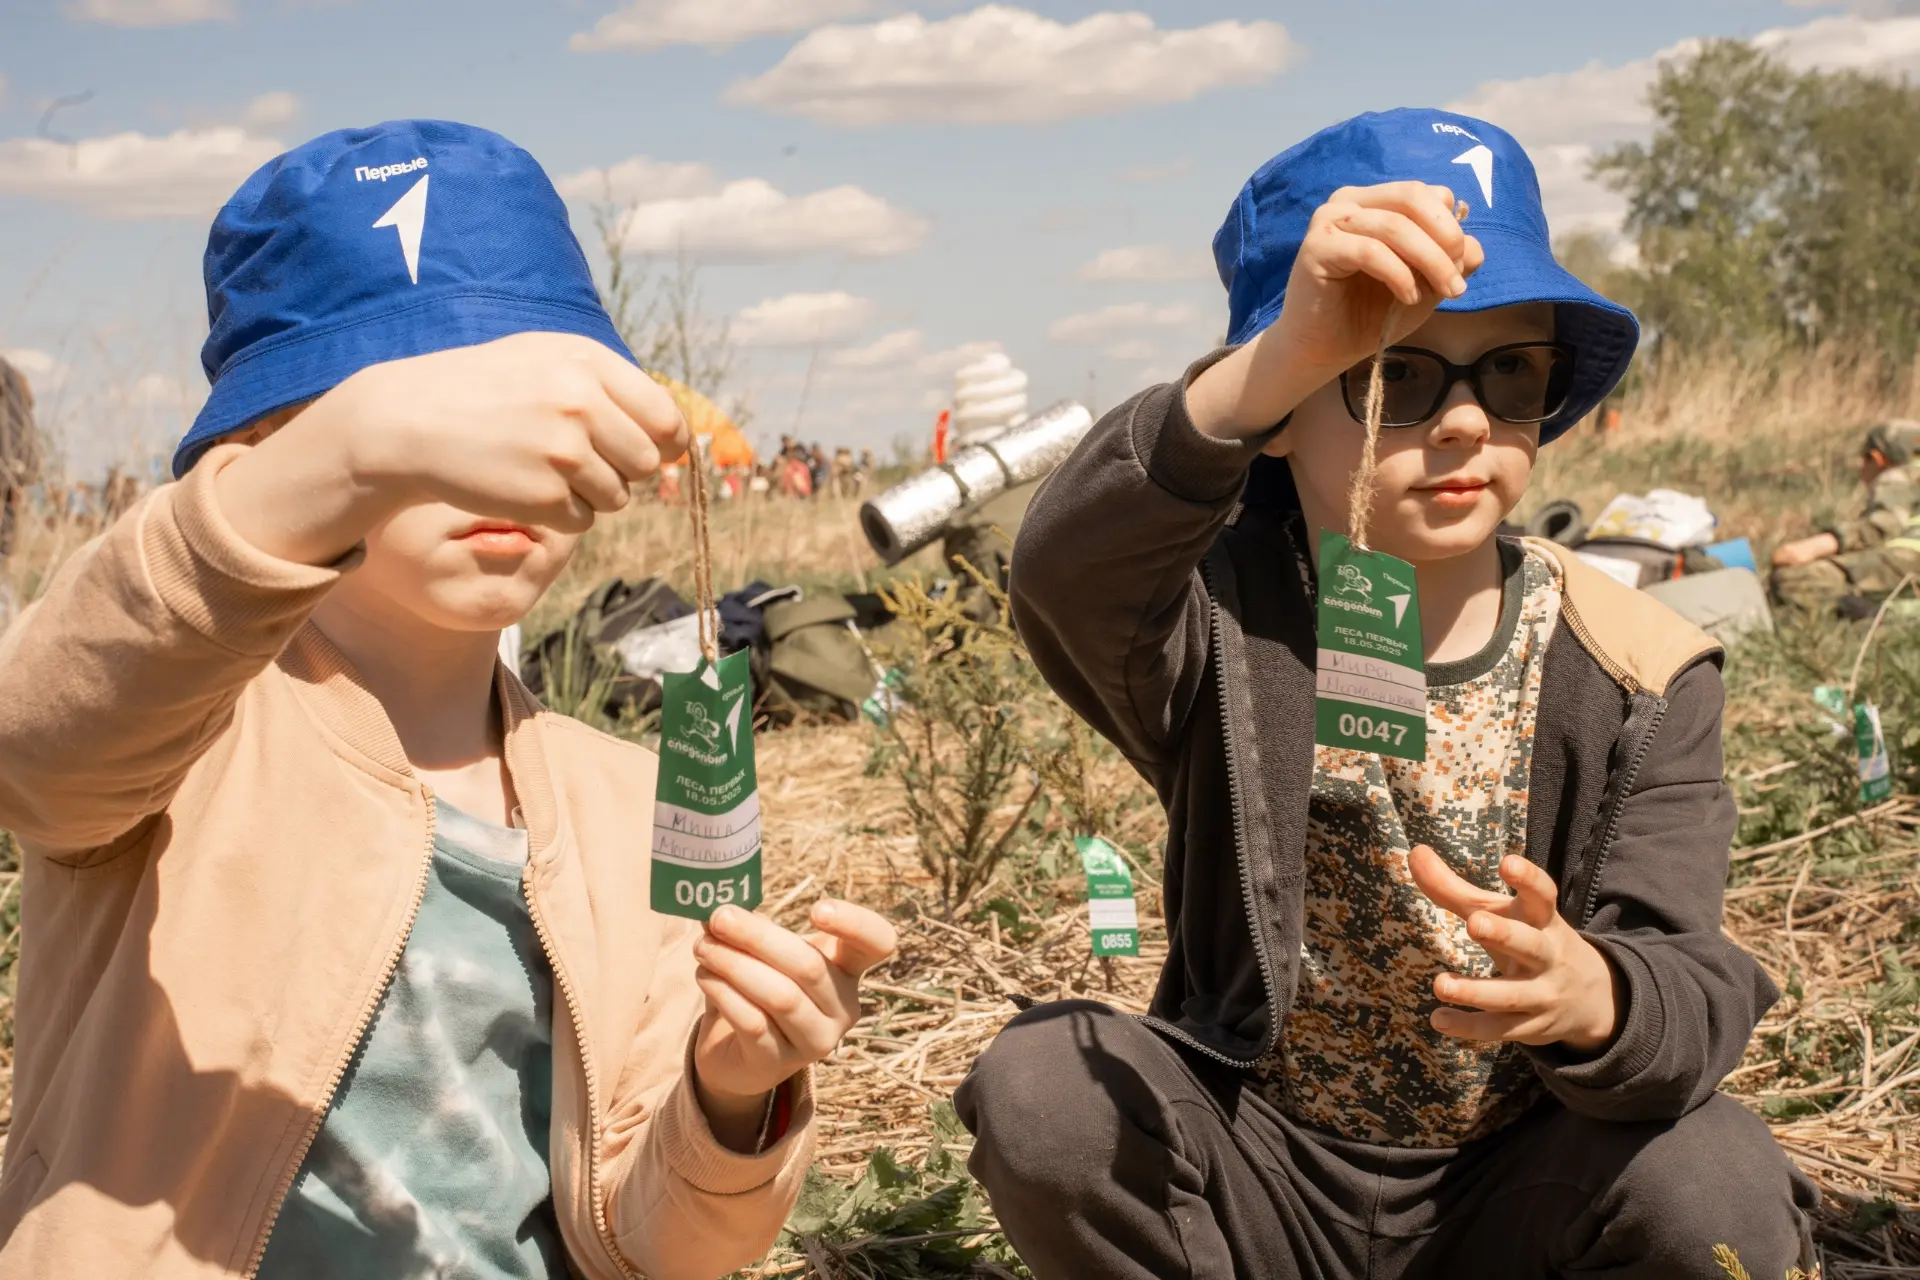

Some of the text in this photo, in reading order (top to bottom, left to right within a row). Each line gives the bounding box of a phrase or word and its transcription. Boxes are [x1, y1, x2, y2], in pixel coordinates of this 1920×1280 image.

[355, 157, 428, 182] Первые
[1334, 626, 1409, 651] ЛЕСА ПЕРВЫХ
[1344, 637, 1402, 656] 18.05.2025
[1339, 713, 1408, 746] 0047
[675, 768, 746, 795] ЛЕСА ПЕРВЫХ
[686, 784, 742, 806] 18.05.2025
[675, 874, 750, 908] 0051
